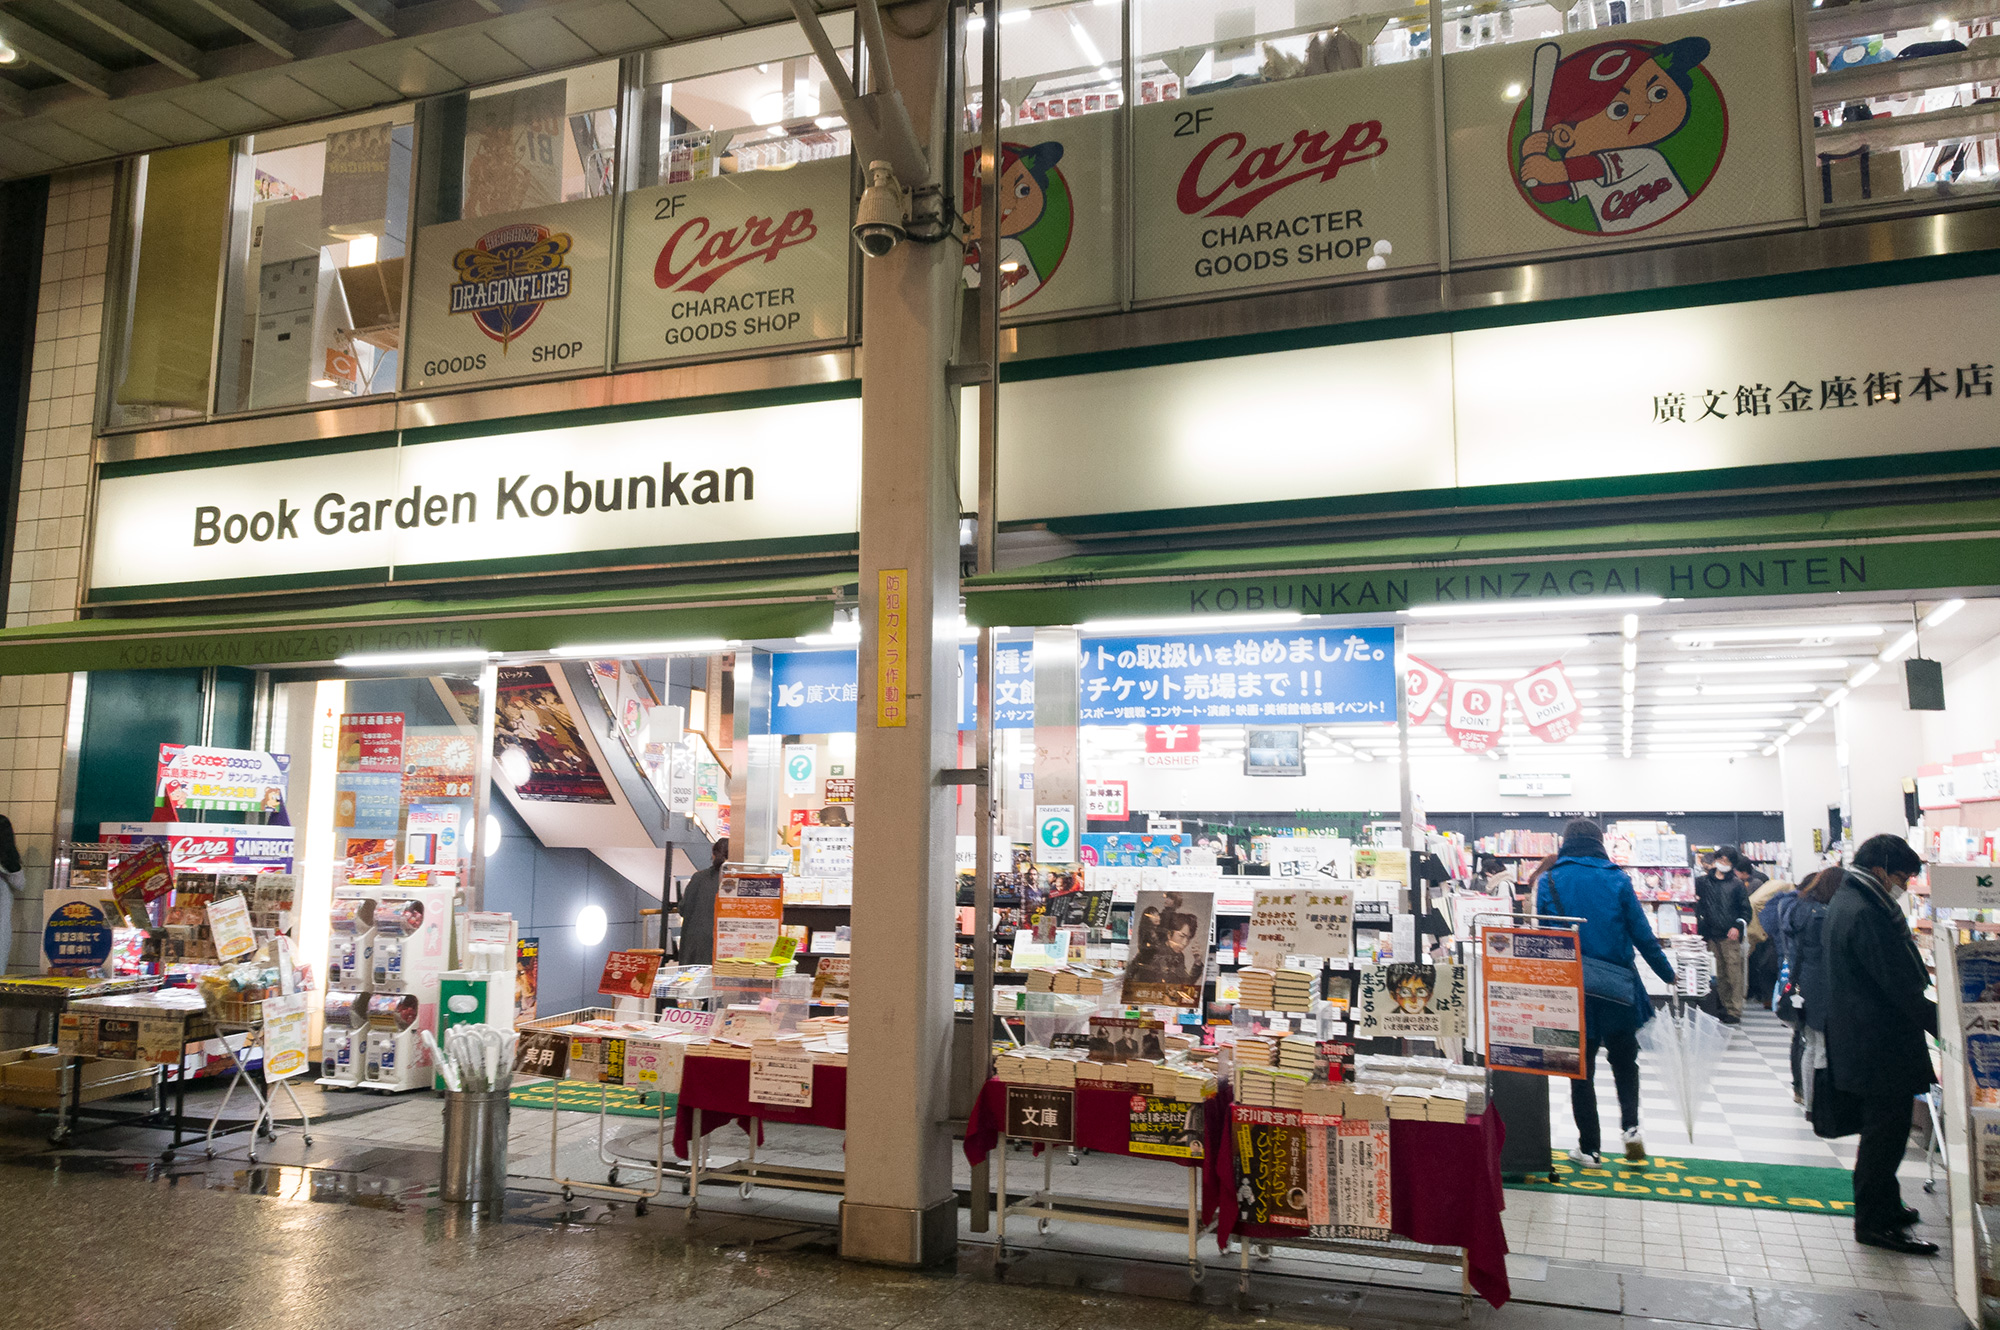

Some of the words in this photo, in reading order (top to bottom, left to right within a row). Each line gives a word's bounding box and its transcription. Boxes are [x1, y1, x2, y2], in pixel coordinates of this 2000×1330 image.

[1173, 107, 1214, 138] 2F
[1177, 119, 1388, 218] Carp
[654, 194, 687, 221] 2F
[1600, 177, 1672, 222] Carp
[1200, 209, 1363, 249] CHARACTER
[653, 207, 818, 294] Carp
[1194, 247, 1289, 277] GOODS
[1296, 236, 1371, 264] SHOP
[451, 270, 570, 312] DRAGONFLIES
[671, 287, 795, 319] CHARACTER
[664, 320, 737, 345] GOODS
[743, 312, 801, 335] SHOP
[424, 354, 487, 377] GOODS
[531, 341, 583, 363] SHOP
[1652, 363, 1994, 424] 廣文館金座街本店
[193, 500, 298, 546] Book
[313, 485, 477, 535] Garden
[495, 460, 755, 520] Kobunkan
[1189, 579, 1409, 613] KOBUNKAN
[1434, 567, 1641, 602] KINZAGAI
[1670, 555, 1867, 591] HONTEN
[121, 639, 241, 664] KOBUNKAN
[253, 633, 364, 658] KINZAGAI
[379, 627, 482, 653] HONTEN
[884, 575, 900, 720] 防犯カメラ作動中
[1459, 716, 1491, 727] POINT
[1147, 755, 1200, 766] CASHIER
[170, 837, 229, 864] Carp
[524, 1048, 556, 1067] 実用
[1021, 1107, 1058, 1128] 文庫
[1255, 1132, 1271, 1224] ひとりいぐも
[1271, 1126, 1288, 1207] おらおらで
